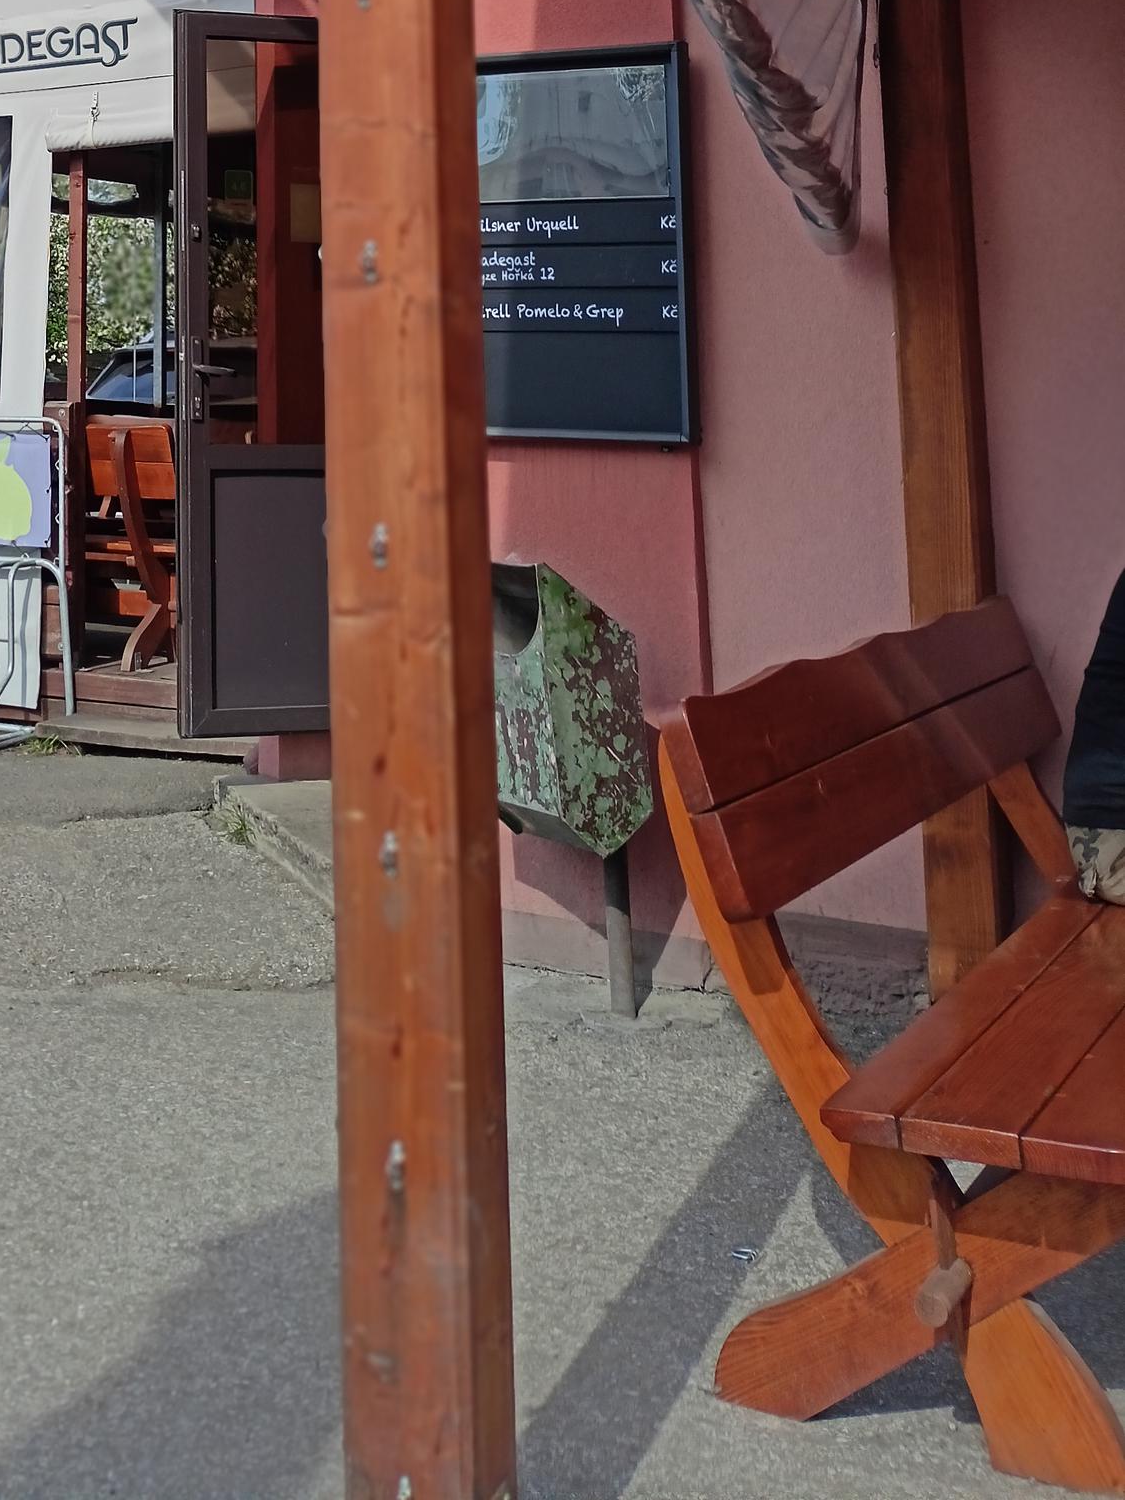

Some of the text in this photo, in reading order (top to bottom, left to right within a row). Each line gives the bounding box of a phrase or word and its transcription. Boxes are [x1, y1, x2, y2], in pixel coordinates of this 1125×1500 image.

[480, 215, 579, 238] ilsner Urquell
[660, 215, 677, 229] Kč
[482, 250, 535, 271] adegast
[661, 259, 677, 273] Kč
[501, 267, 535, 281] Hořká
[540, 267, 555, 281] 12
[517, 303, 570, 319] Pomelo
[573, 303, 583, 319] &
[586, 303, 624, 327] Grep
[662, 304, 678, 319] Kč
